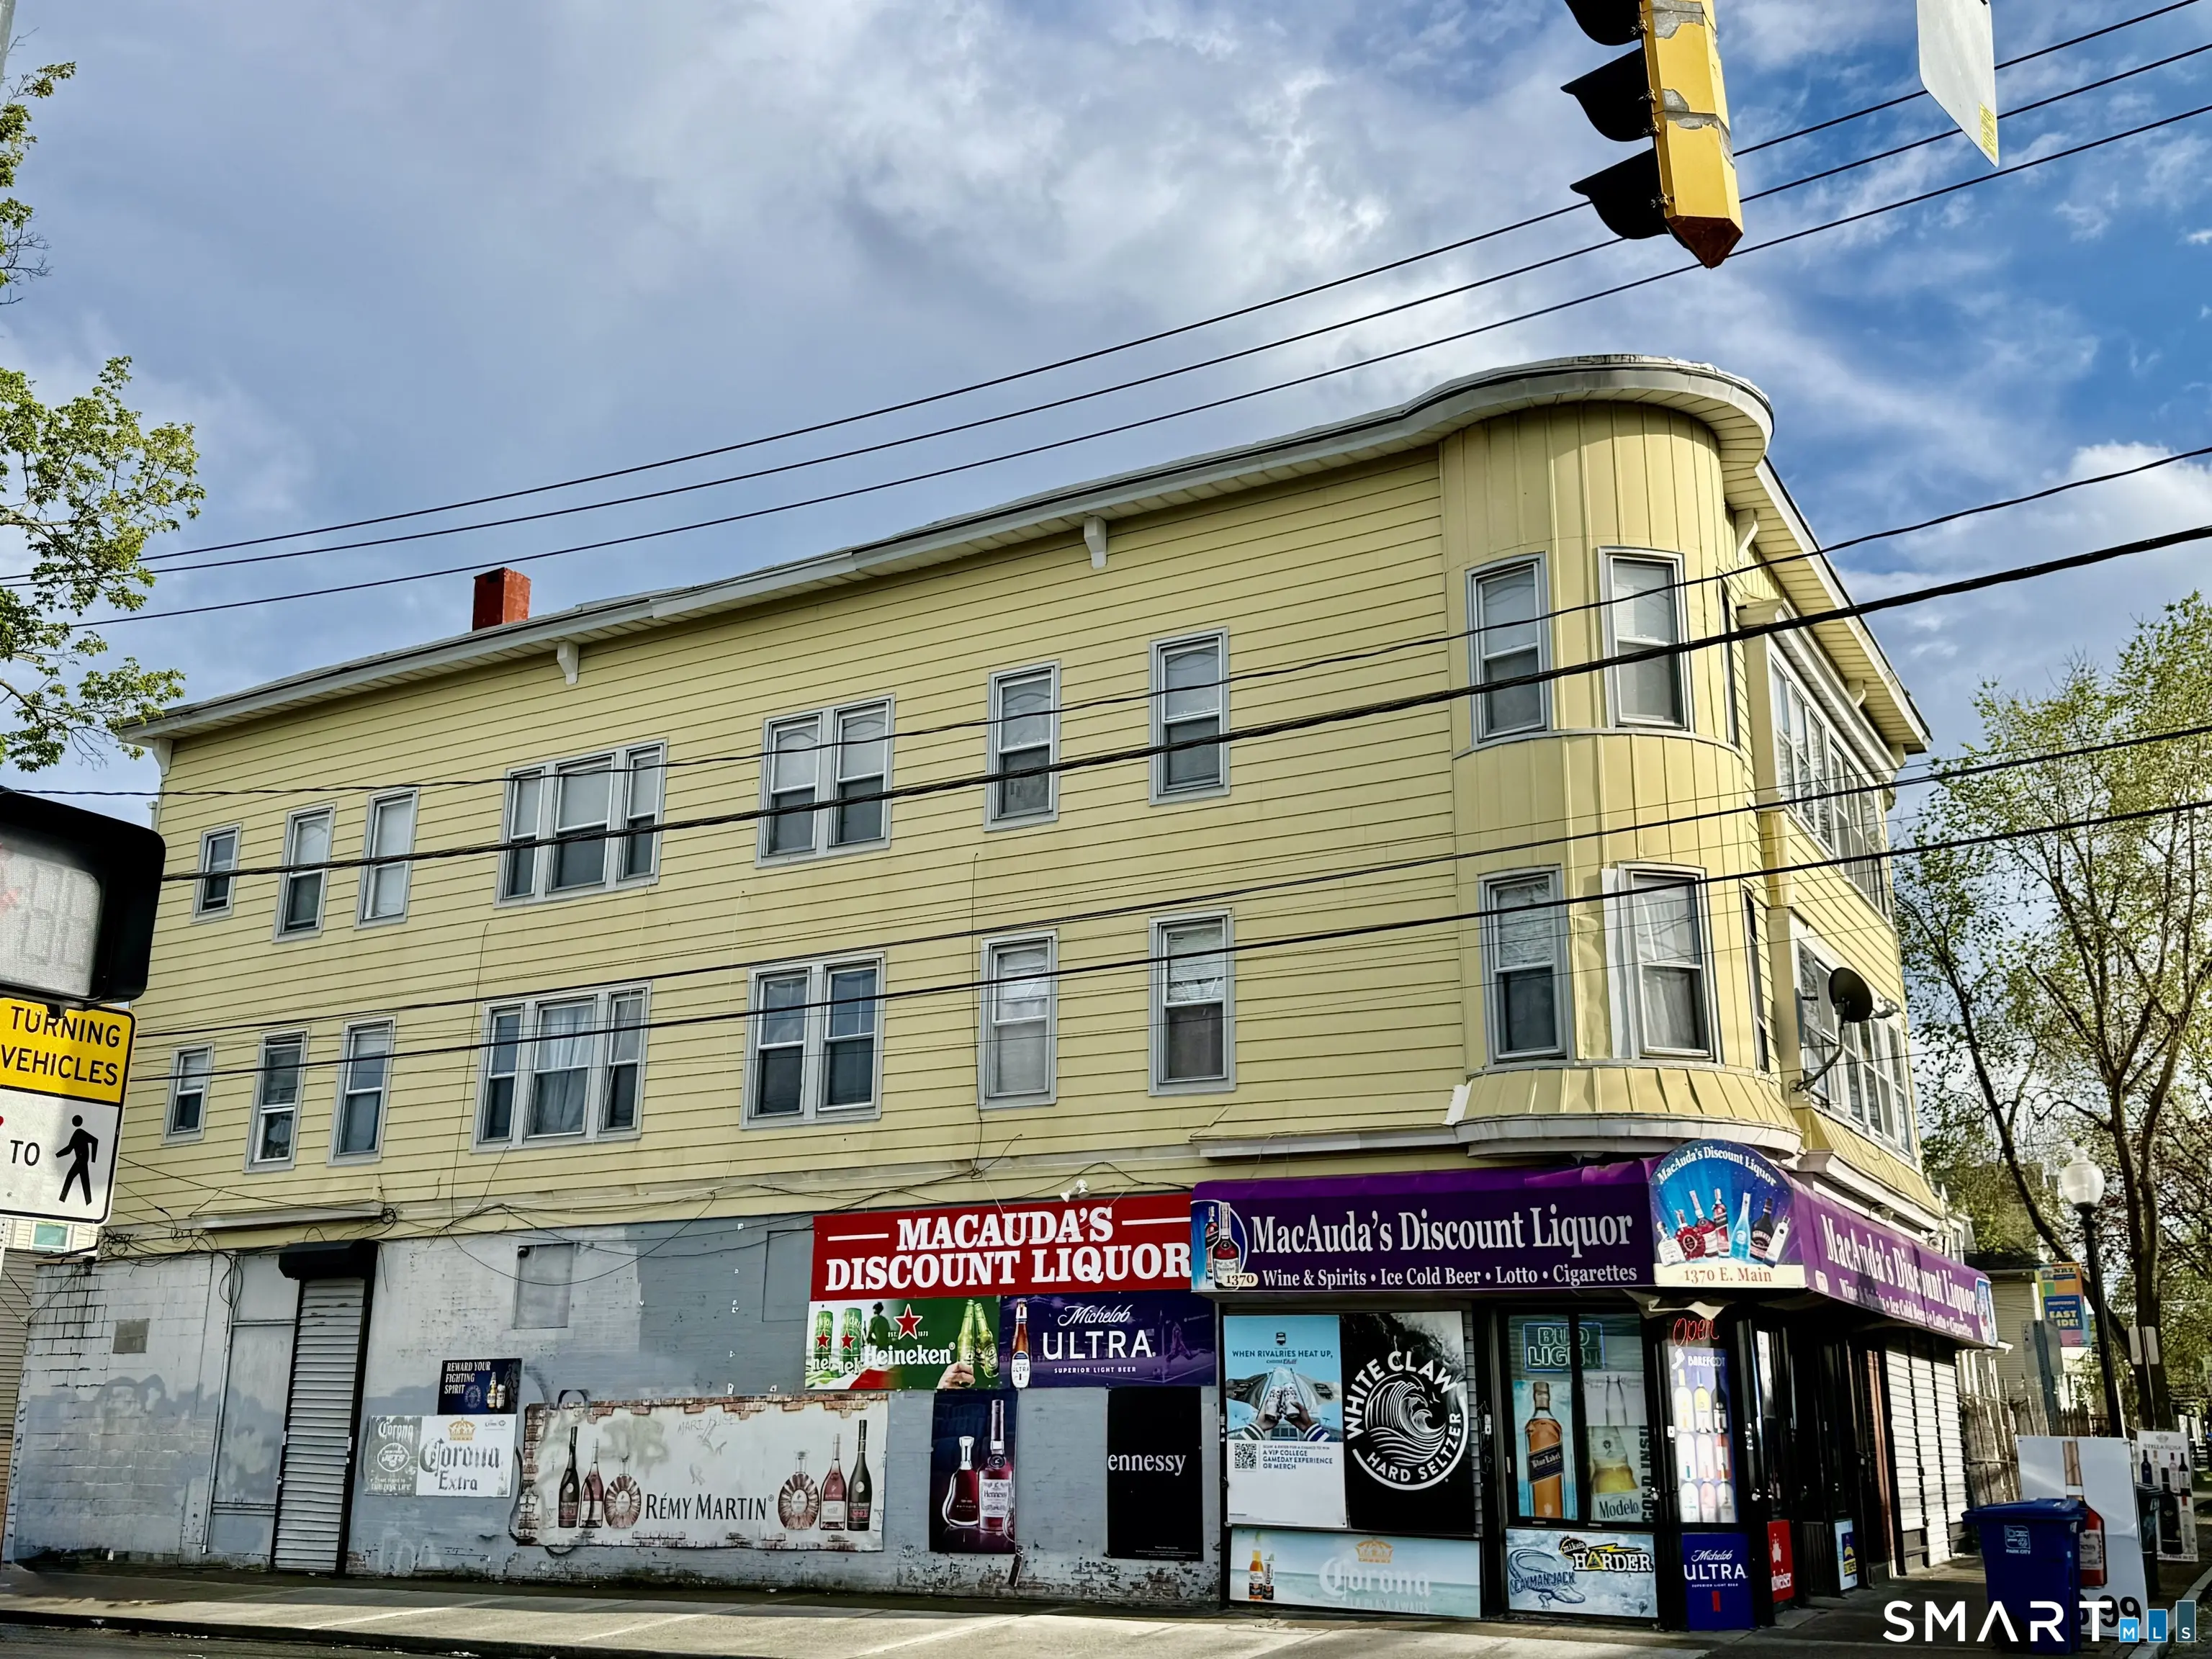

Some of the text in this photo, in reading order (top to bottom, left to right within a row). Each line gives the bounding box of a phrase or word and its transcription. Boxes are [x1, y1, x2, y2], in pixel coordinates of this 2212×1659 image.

[12, 1005, 120, 1047] TURNING
[1, 1043, 118, 1086] VEHICLES
[10, 1139, 40, 1166] TO
[1657, 1146, 1777, 1187] MacAuda's Discount Liquor
[896, 1207, 1113, 1251] MACAUDA'S
[1251, 1204, 1633, 1258] MacAuda's Discount Liquor
[825, 1243, 1192, 1292] DISCOUNT LIQUOR
[1262, 1263, 1637, 1289] Wine & Spirits Ice Cold Beer Lotto Cigarettes
[1684, 1267, 1772, 1285] 1370 E. Main
[1226, 1274, 1254, 1286] 1370
[1942, 1269, 1977, 1321] Liquor
[1058, 1305, 1133, 1326] Michelob
[1899, 1299, 1912, 1318] Cold
[1538, 1327, 1589, 1346] BUD
[1673, 1318, 1719, 1347] Open
[1043, 1330, 1154, 1359] ULTRA
[1321, 1350, 1333, 1359] UP,
[863, 1345, 952, 1366] Heineken
[1688, 1356, 1725, 1367] BAREFOOT
[446, 1361, 490, 1372] REWARD YOUR
[446, 1373, 475, 1382] FIGHTING
[444, 1385, 465, 1394] SPIRIT
[1344, 1351, 1458, 1439] WHITE CLAW
[378, 1421, 413, 1441] Corona
[419, 1438, 500, 1476] Corona
[1367, 1451, 1411, 1483] HARD
[1419, 1412, 1462, 1480] SELTZER
[1107, 1454, 1186, 1476] ennessy
[1532, 1452, 1561, 1469] Blue Label
[439, 1470, 477, 1491] Extra
[646, 1492, 766, 1520] RÉMY MARTIN
[1599, 1498, 1639, 1519] Modelo
[1573, 1552, 1654, 1573] HARDER
[1691, 1550, 1733, 1562] Michelob
[1319, 1556, 1431, 1601] Corona
[1550, 1571, 1576, 1586] JACK
[1683, 1563, 1747, 1581] ULTRA
